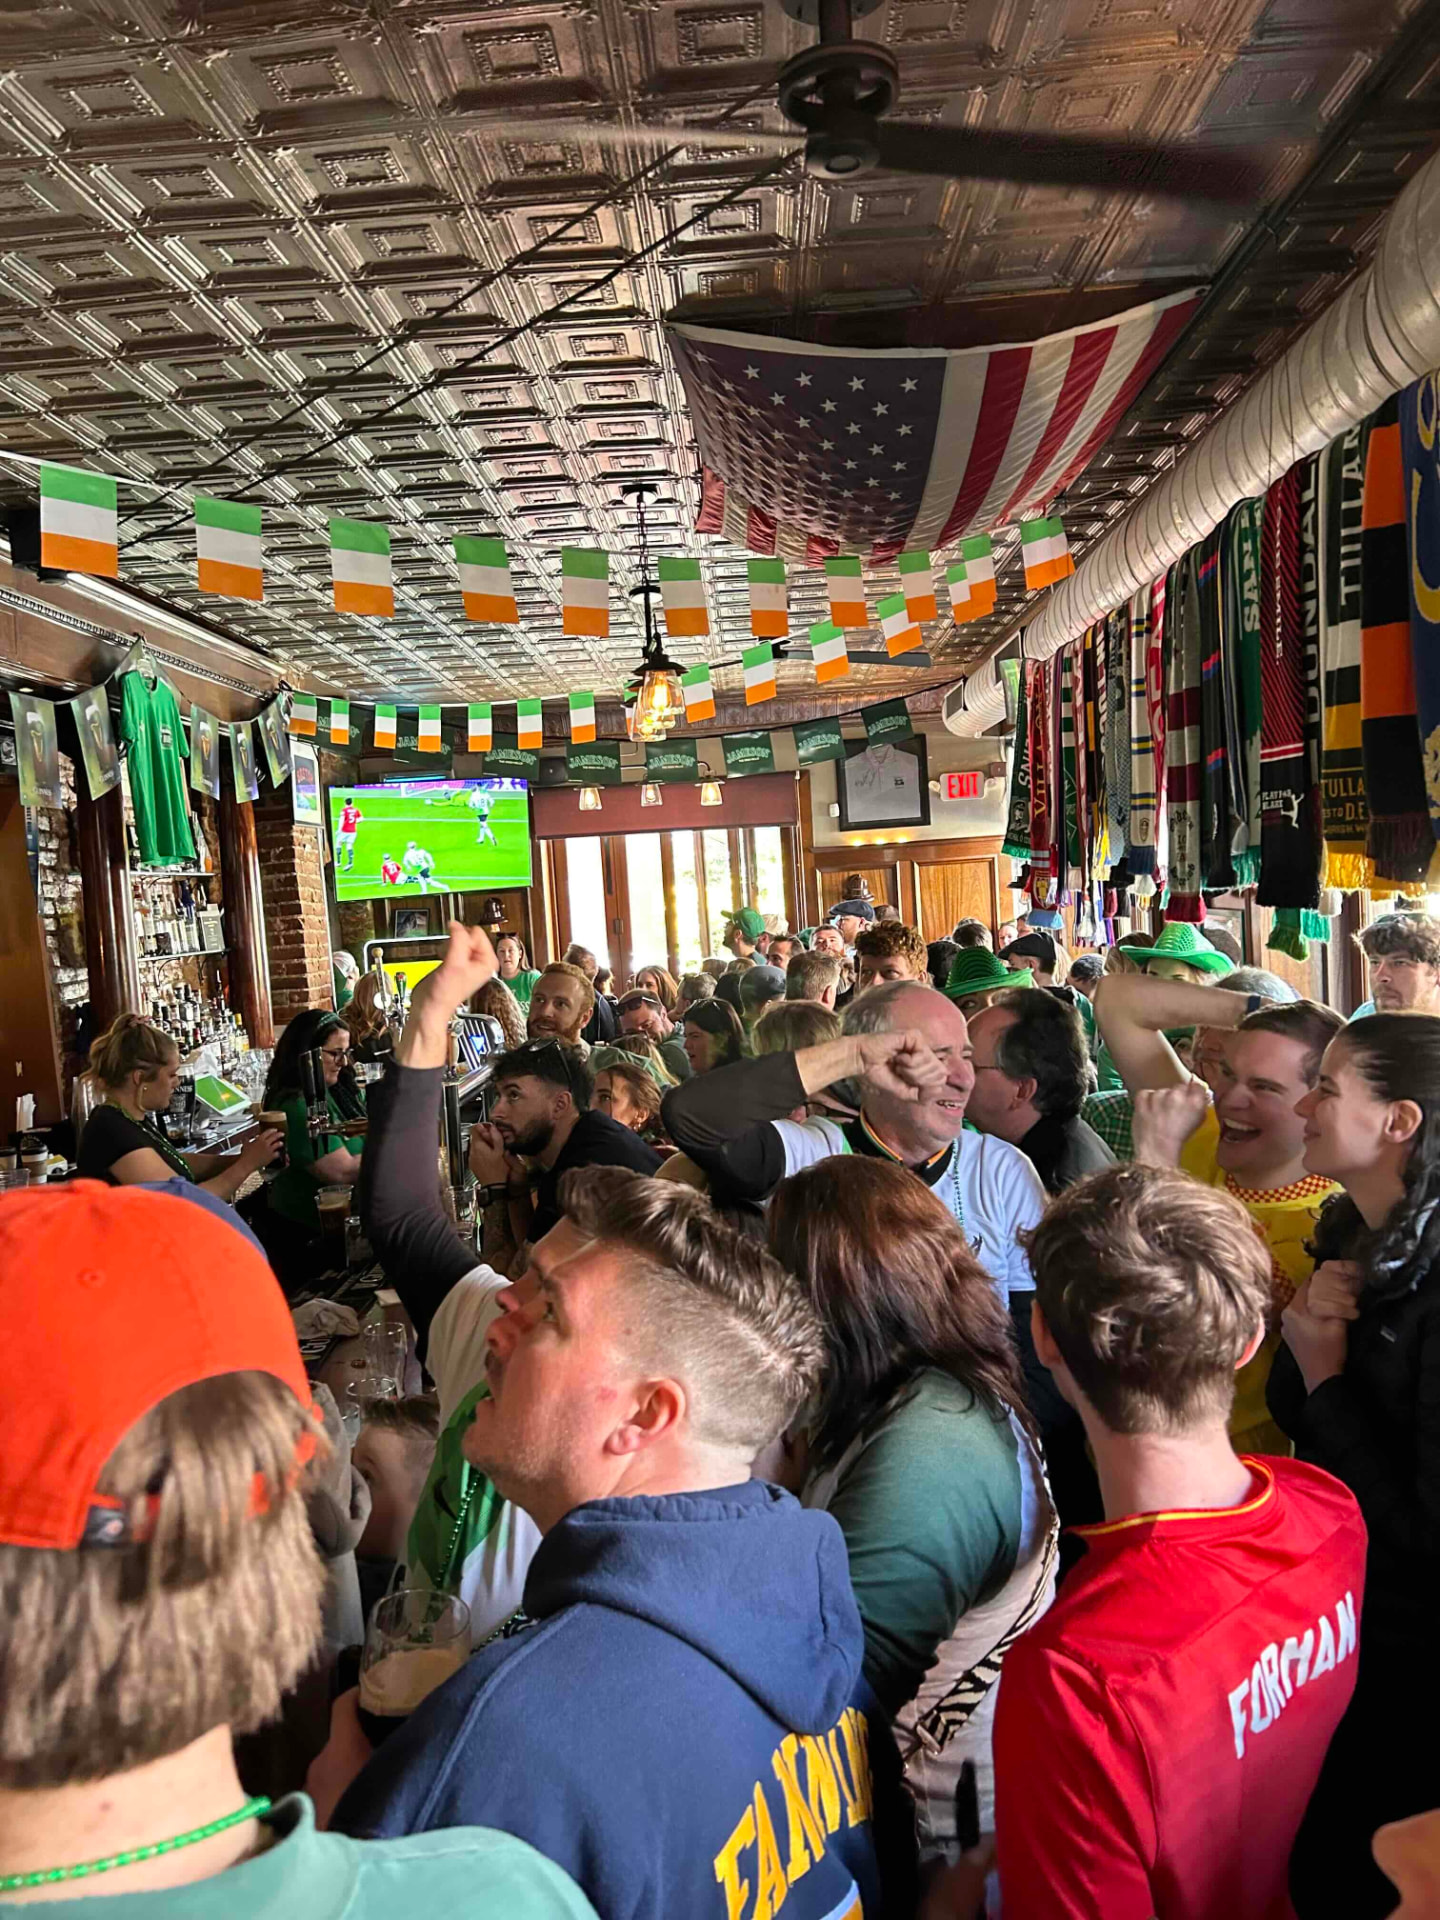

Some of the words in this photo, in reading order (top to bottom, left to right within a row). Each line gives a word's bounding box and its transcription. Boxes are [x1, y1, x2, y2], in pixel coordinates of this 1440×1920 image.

[867, 715, 908, 736] JAMESON
[798, 732, 840, 750] JAMESON
[484, 748, 537, 766] JAMESON
[568, 754, 619, 769] JAMESON
[648, 753, 696, 770] JAMESON
[727, 746, 771, 764] JAMESON
[947, 773, 979, 799] EXIT
[1228, 1590, 1356, 1760] FORMAN
